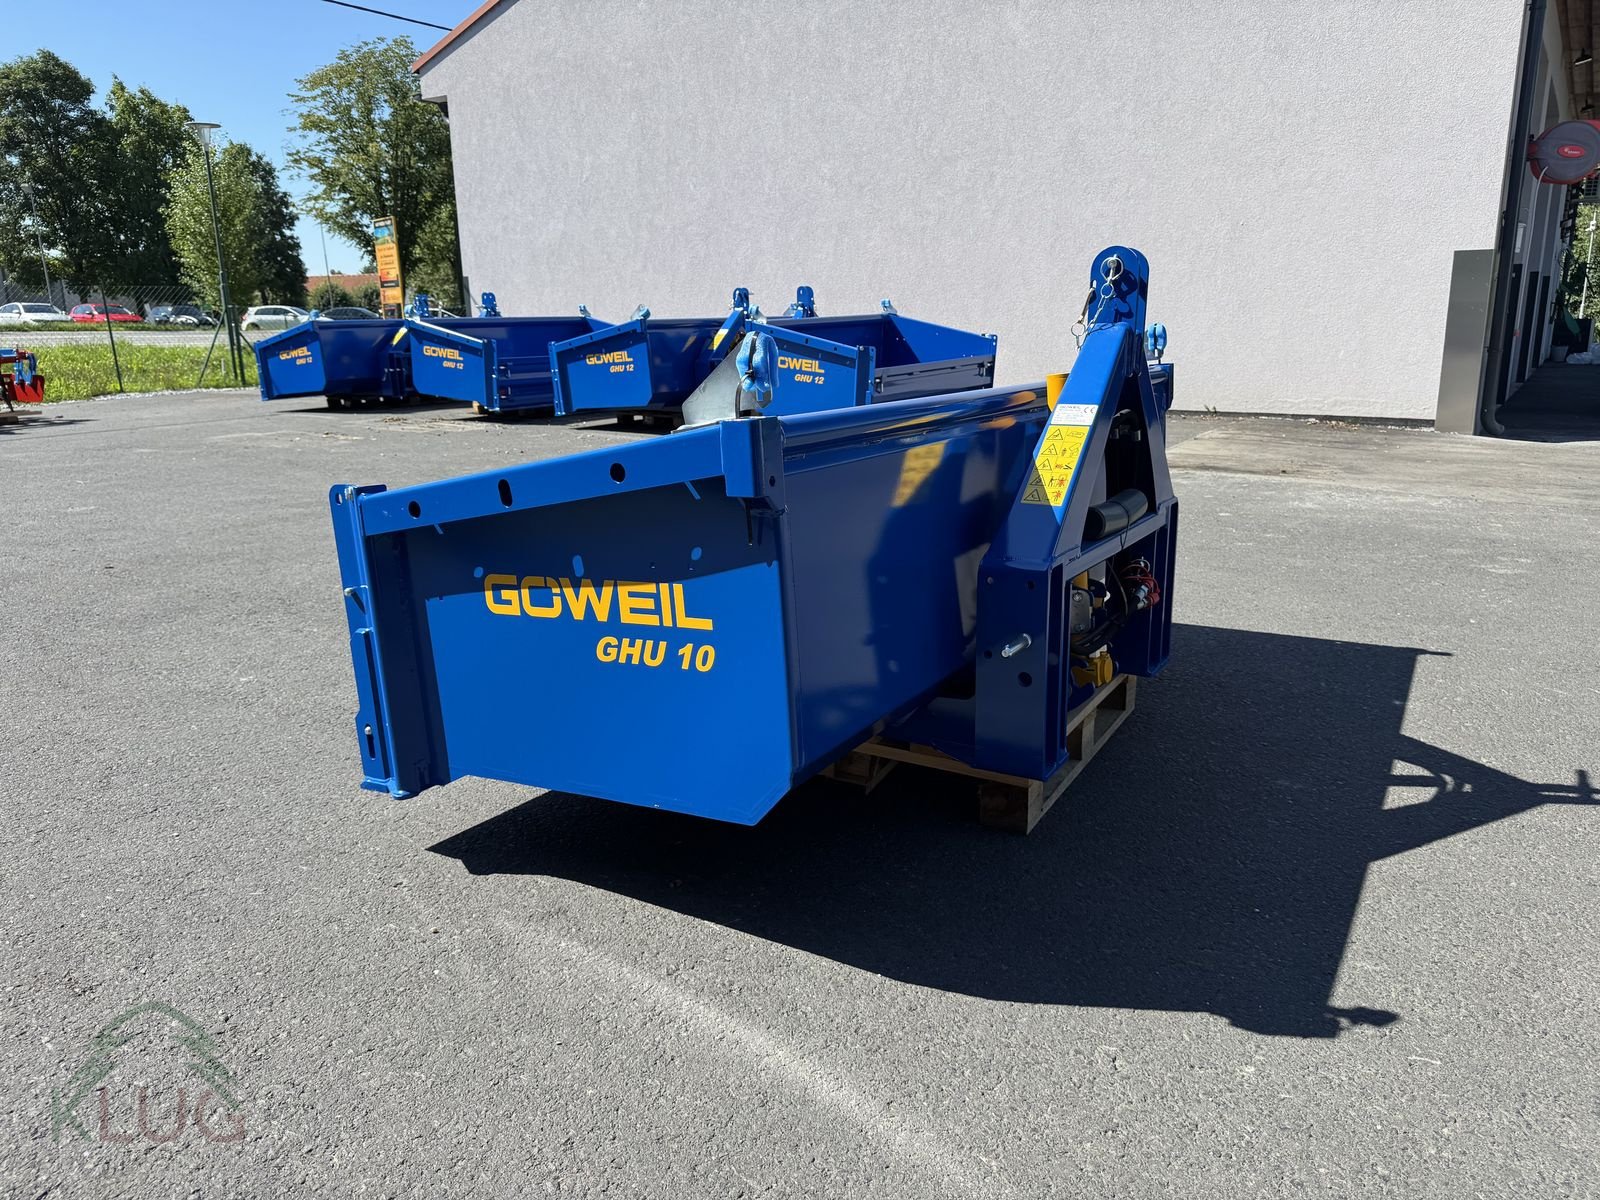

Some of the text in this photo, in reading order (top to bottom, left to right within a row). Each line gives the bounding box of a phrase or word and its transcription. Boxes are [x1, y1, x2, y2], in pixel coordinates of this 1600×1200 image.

[609, 364, 634, 373] GHU 12
[794, 373, 825, 385] GHU 12
[596, 636, 715, 672] GHU 10
